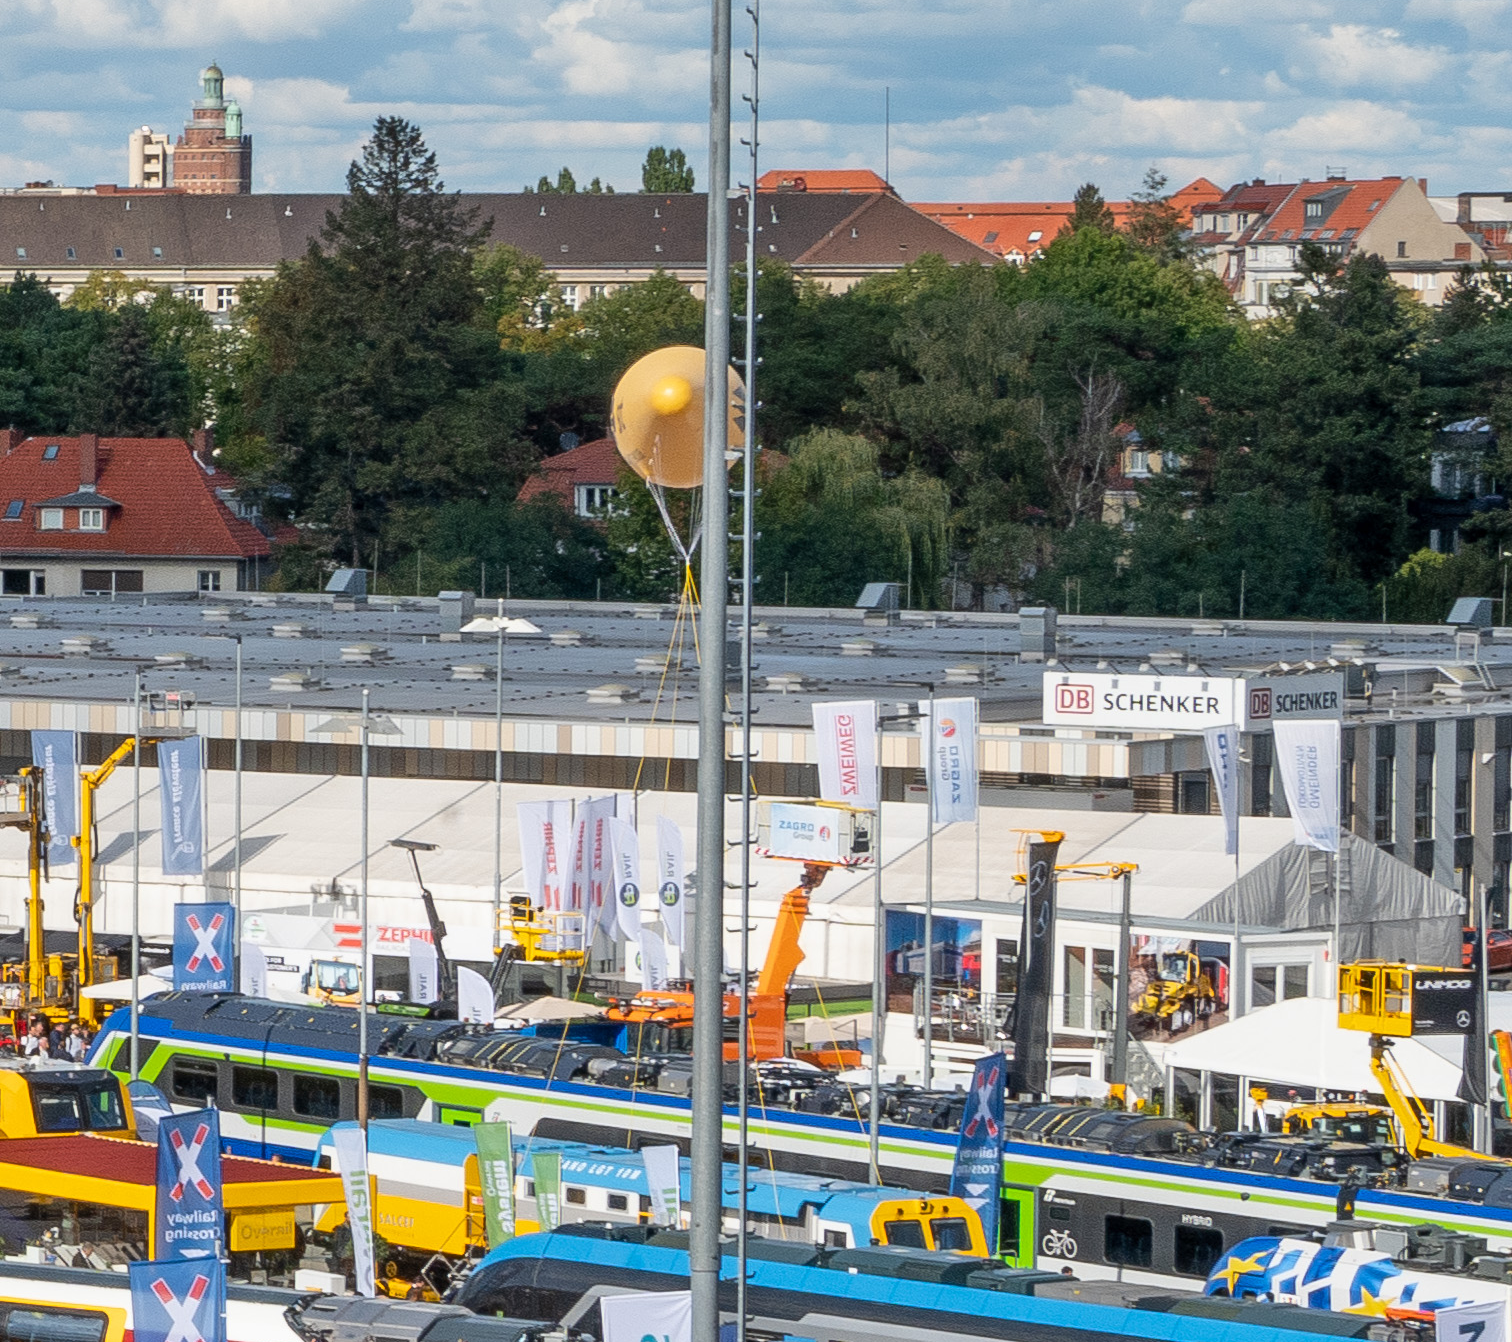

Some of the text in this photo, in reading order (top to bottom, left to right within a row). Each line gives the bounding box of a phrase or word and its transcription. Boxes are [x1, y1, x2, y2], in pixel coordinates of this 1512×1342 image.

[1058, 687, 1219, 714] DB SCHENKER
[1251, 690, 1338, 715] DB SCHENKER
[778, 820, 815, 832] ZAGRO
[1415, 979, 1472, 991] UNIMOG
